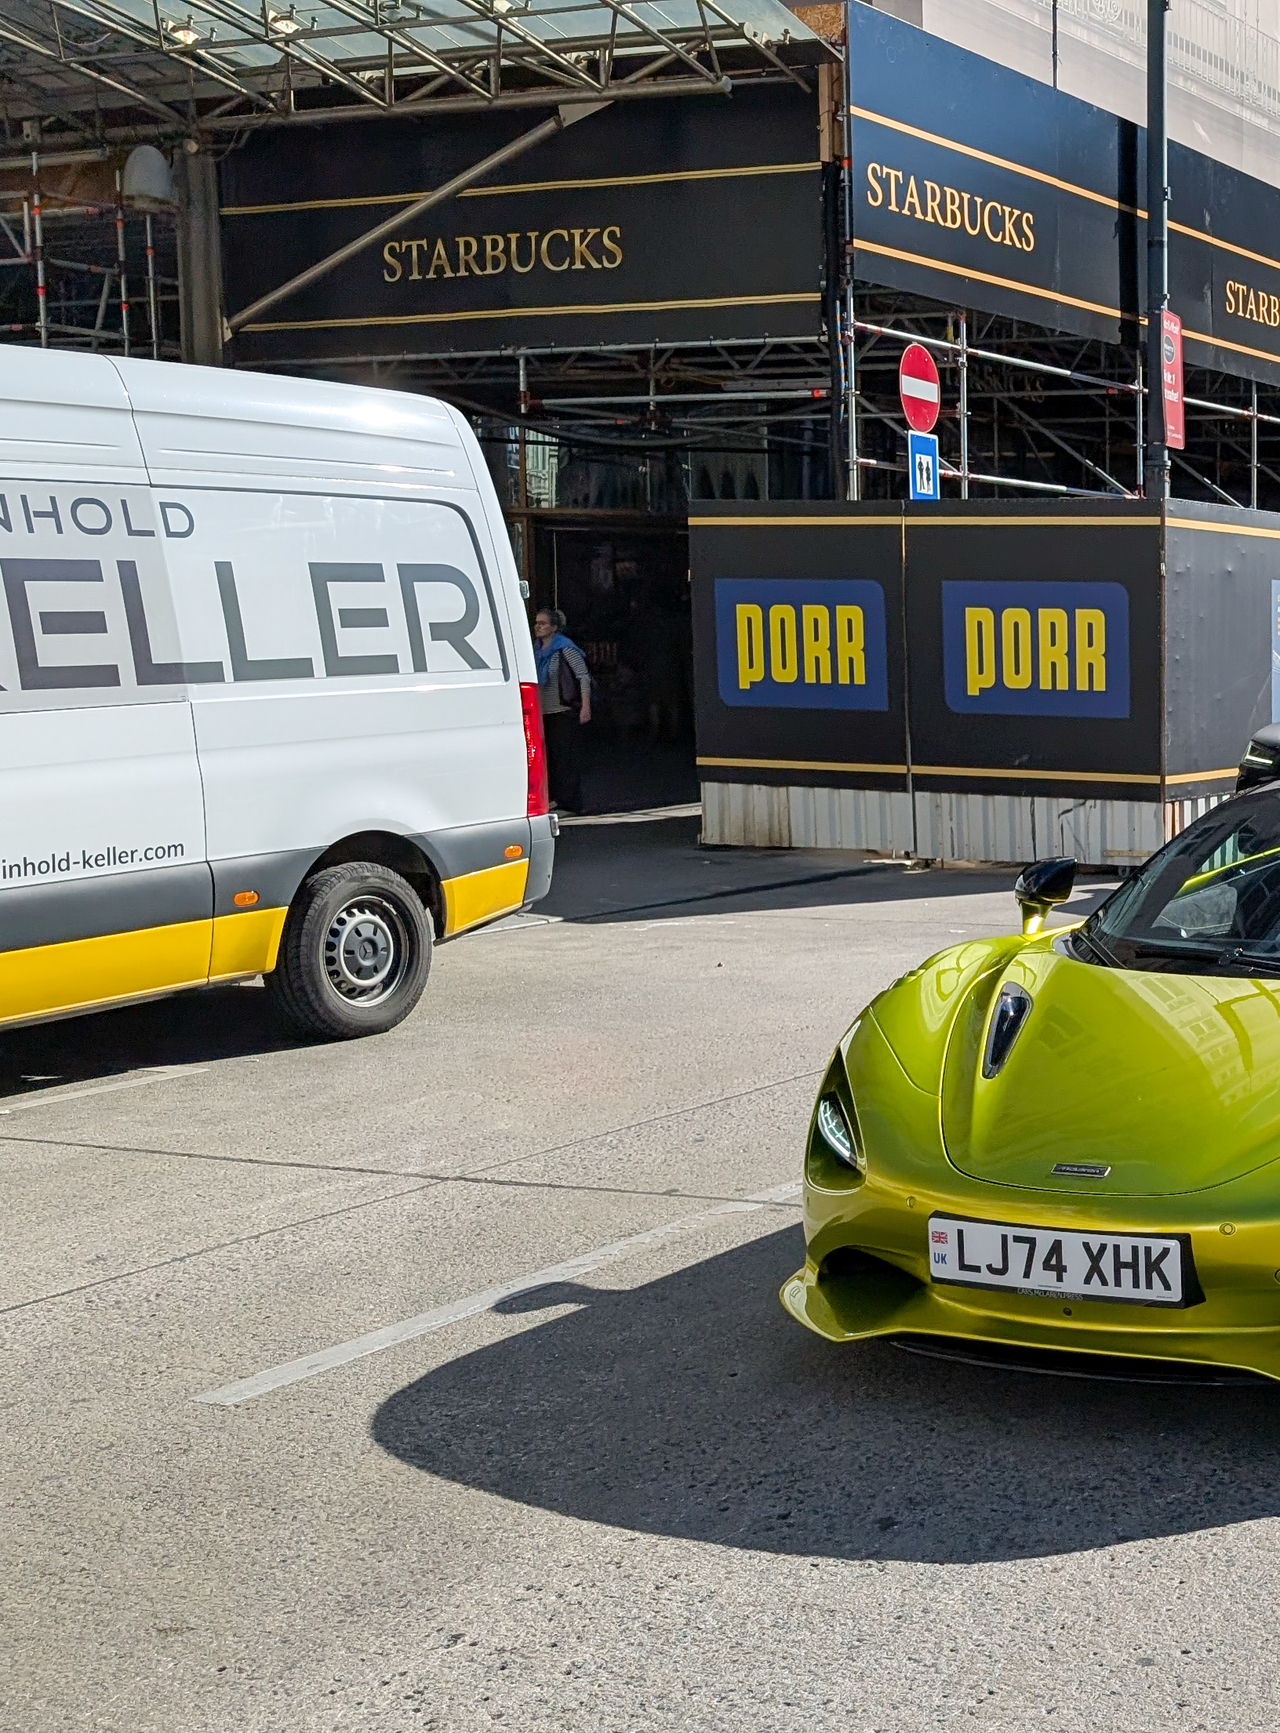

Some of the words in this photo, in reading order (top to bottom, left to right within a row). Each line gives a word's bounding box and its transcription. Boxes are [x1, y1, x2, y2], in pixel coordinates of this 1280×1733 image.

[866, 162, 1035, 253] STARBUCKS
[382, 226, 624, 283] STARBUCKS
[0, 558, 490, 691] ELLER
[735, 602, 867, 691] PORR
[965, 606, 1107, 697] PORR
[1, 842, 185, 880] inhold-keller.com
[933, 1252, 948, 1265] UK
[957, 1228, 1068, 1283] LJ74
[1082, 1241, 1171, 1292] XHK
